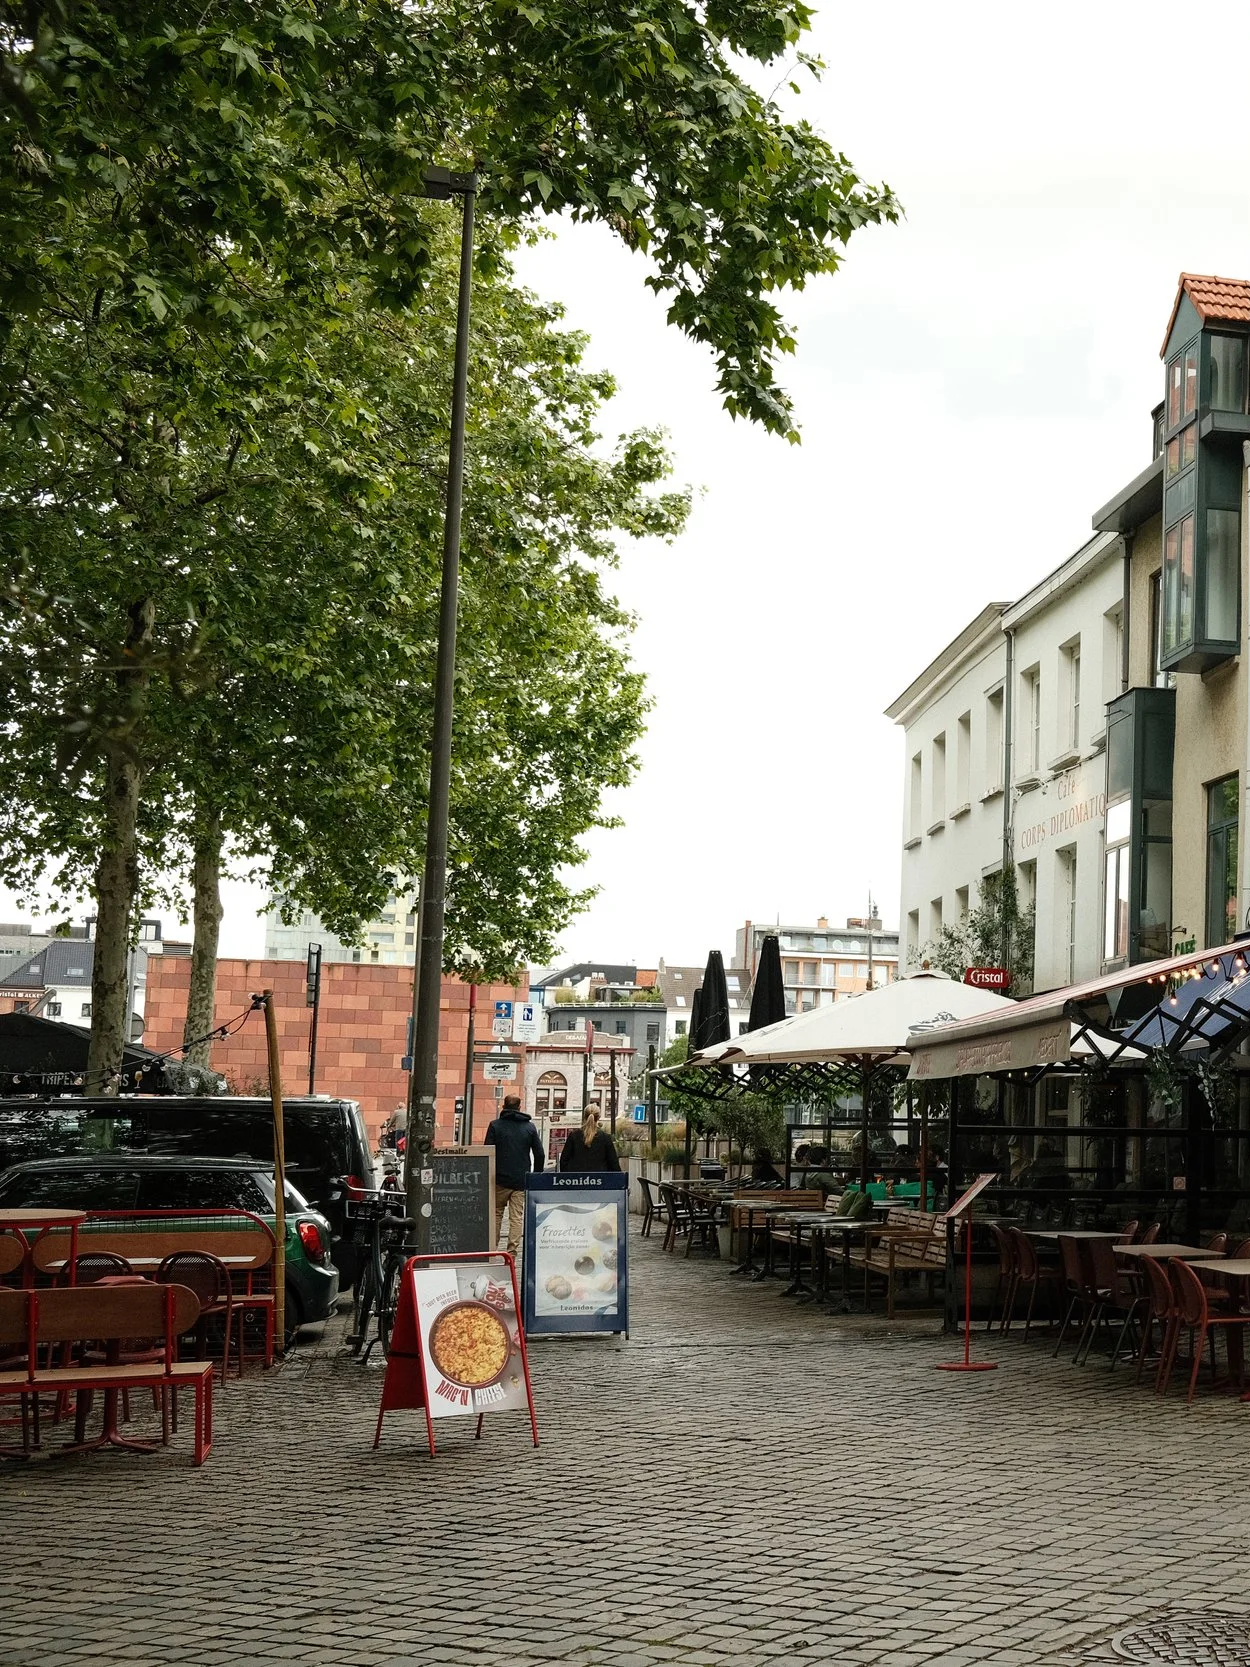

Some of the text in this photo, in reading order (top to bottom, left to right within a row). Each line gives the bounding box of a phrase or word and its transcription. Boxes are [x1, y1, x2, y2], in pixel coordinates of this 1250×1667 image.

[1021, 822, 1046, 849] CORPS
[970, 970, 1004, 985] Cristal
[552, 1176, 603, 1186] Leonidas
[542, 1225, 586, 1237] Frozettes
[560, 1304, 594, 1312] Leonidas
[435, 1379, 507, 1406] MAC'N CHEESE
